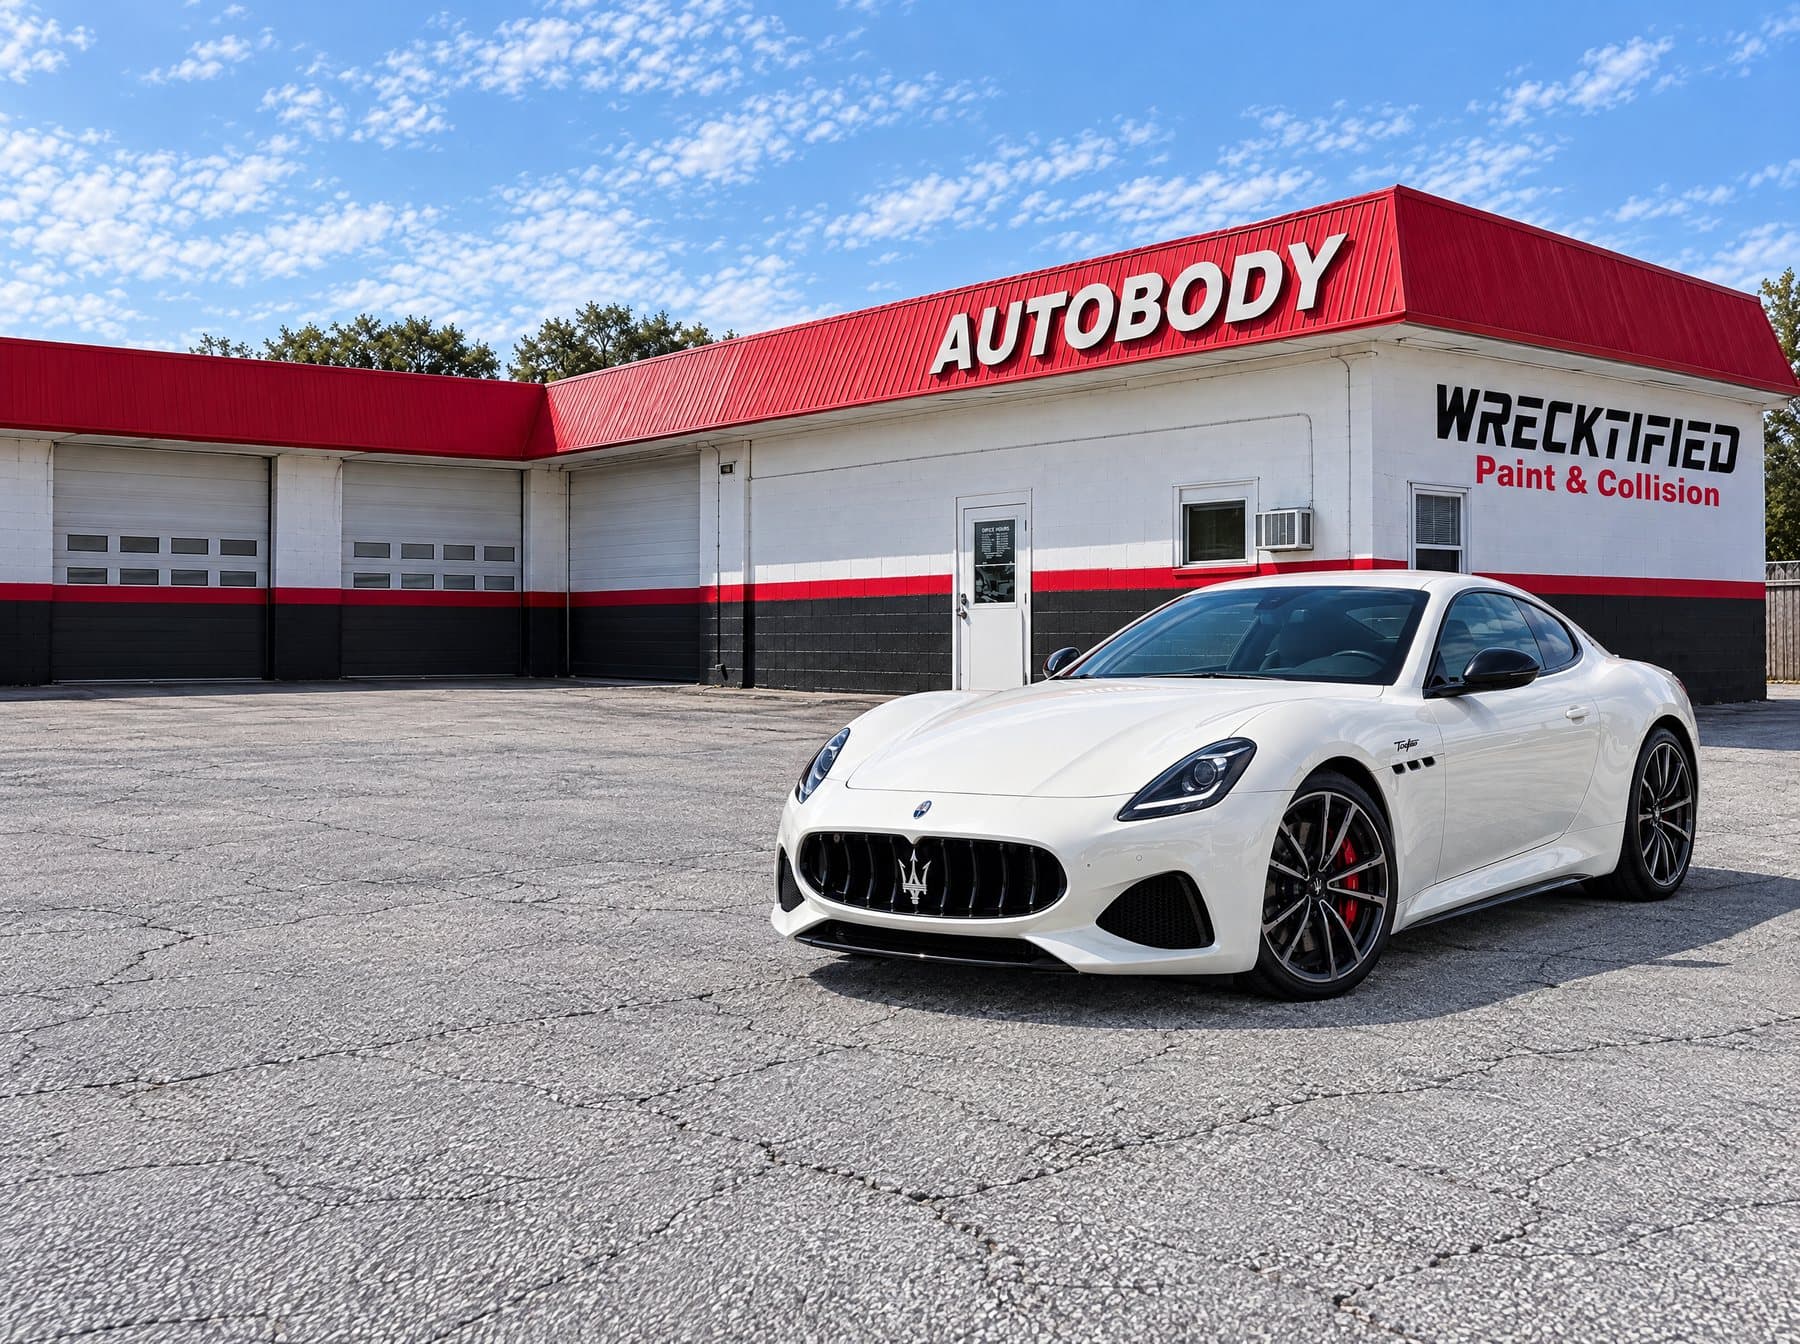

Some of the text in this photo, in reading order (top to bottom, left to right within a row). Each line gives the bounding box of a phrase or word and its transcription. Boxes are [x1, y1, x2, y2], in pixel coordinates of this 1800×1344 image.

[929, 233, 1347, 375] AUTOBODY
[1437, 384, 1740, 474] WRECKTIFIED
[1477, 455, 1720, 507] Paint & Collision
